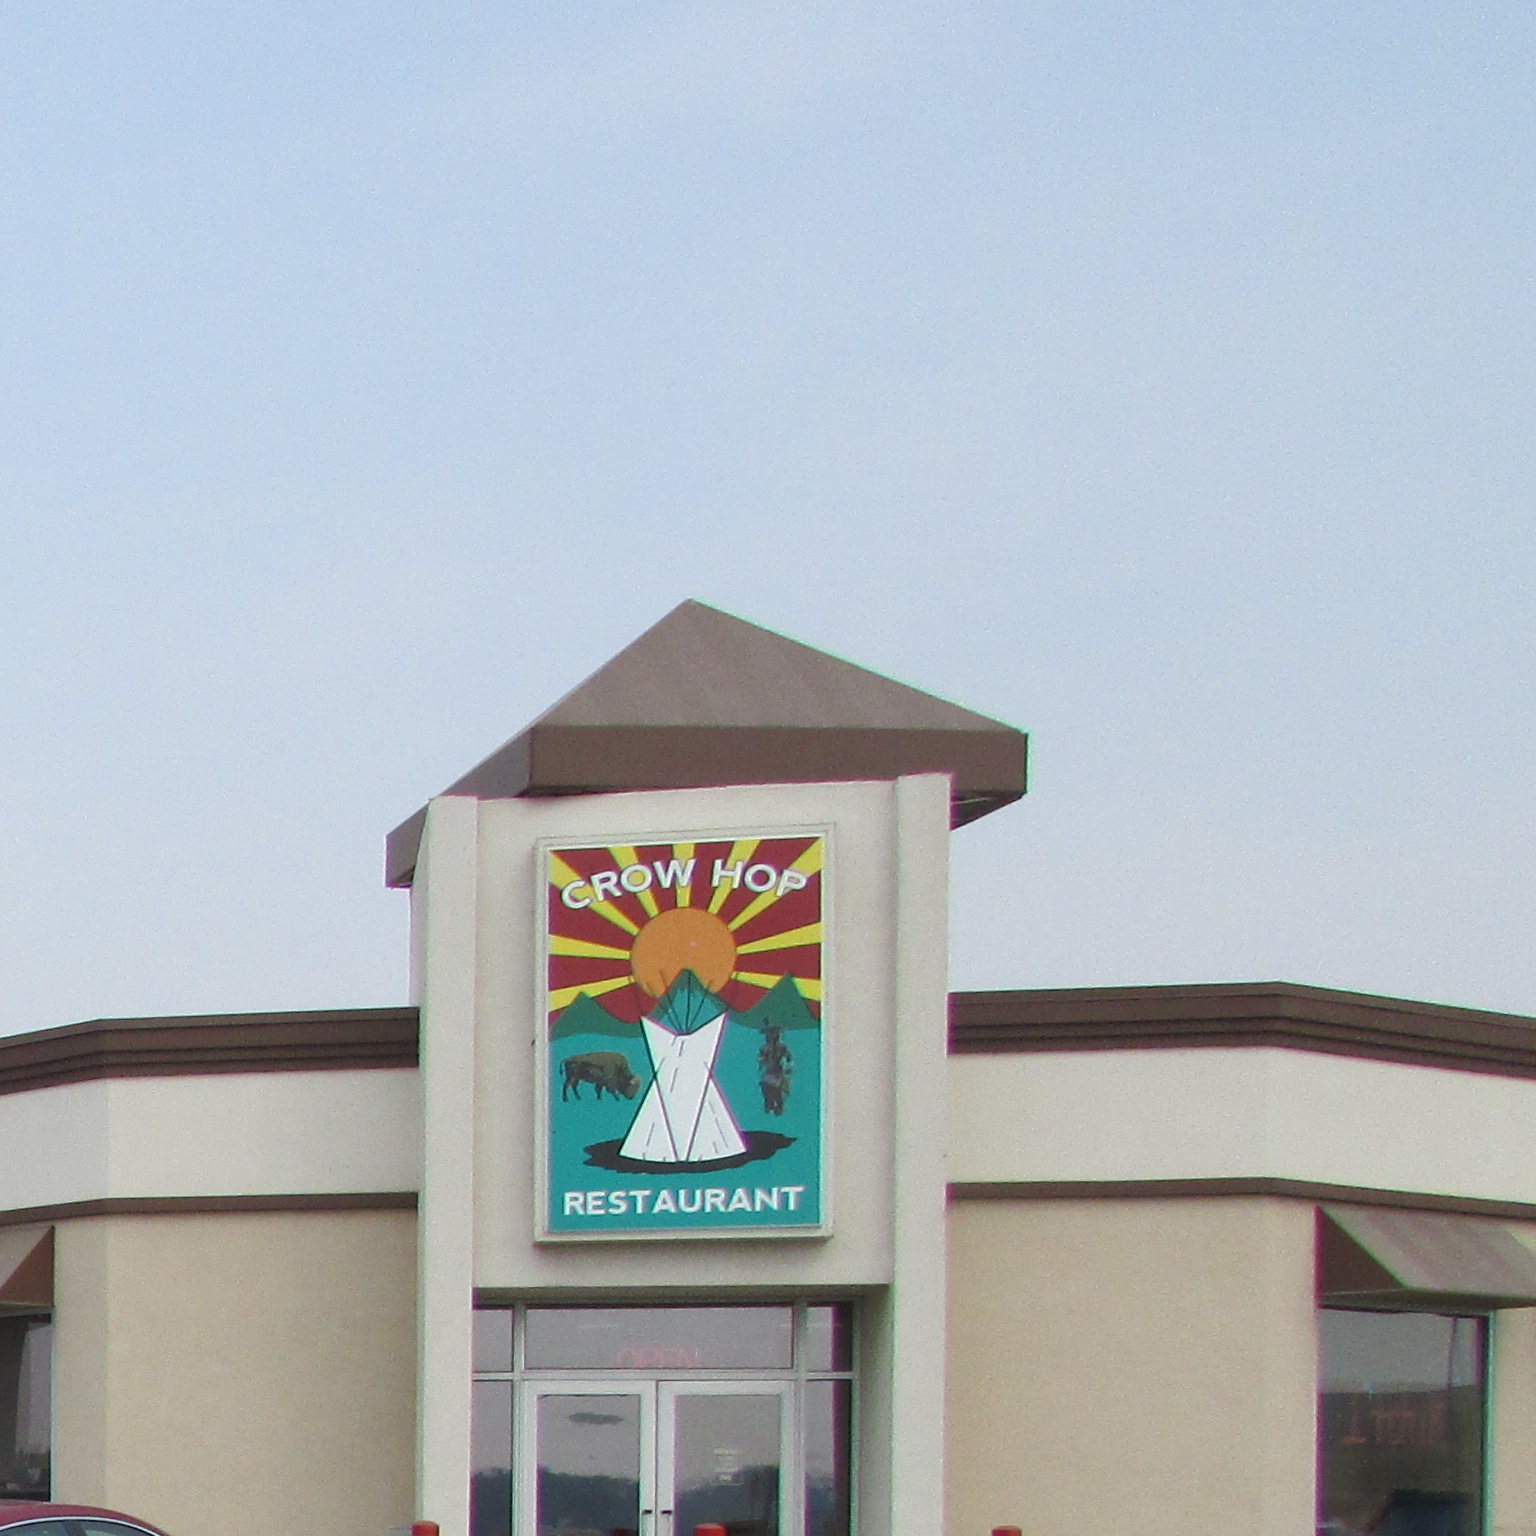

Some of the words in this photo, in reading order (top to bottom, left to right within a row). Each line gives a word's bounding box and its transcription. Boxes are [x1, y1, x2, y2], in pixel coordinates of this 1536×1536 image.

[561, 858, 696, 909] CROW
[711, 858, 808, 898] HOP
[563, 1185, 806, 1216] RESTAURANT
